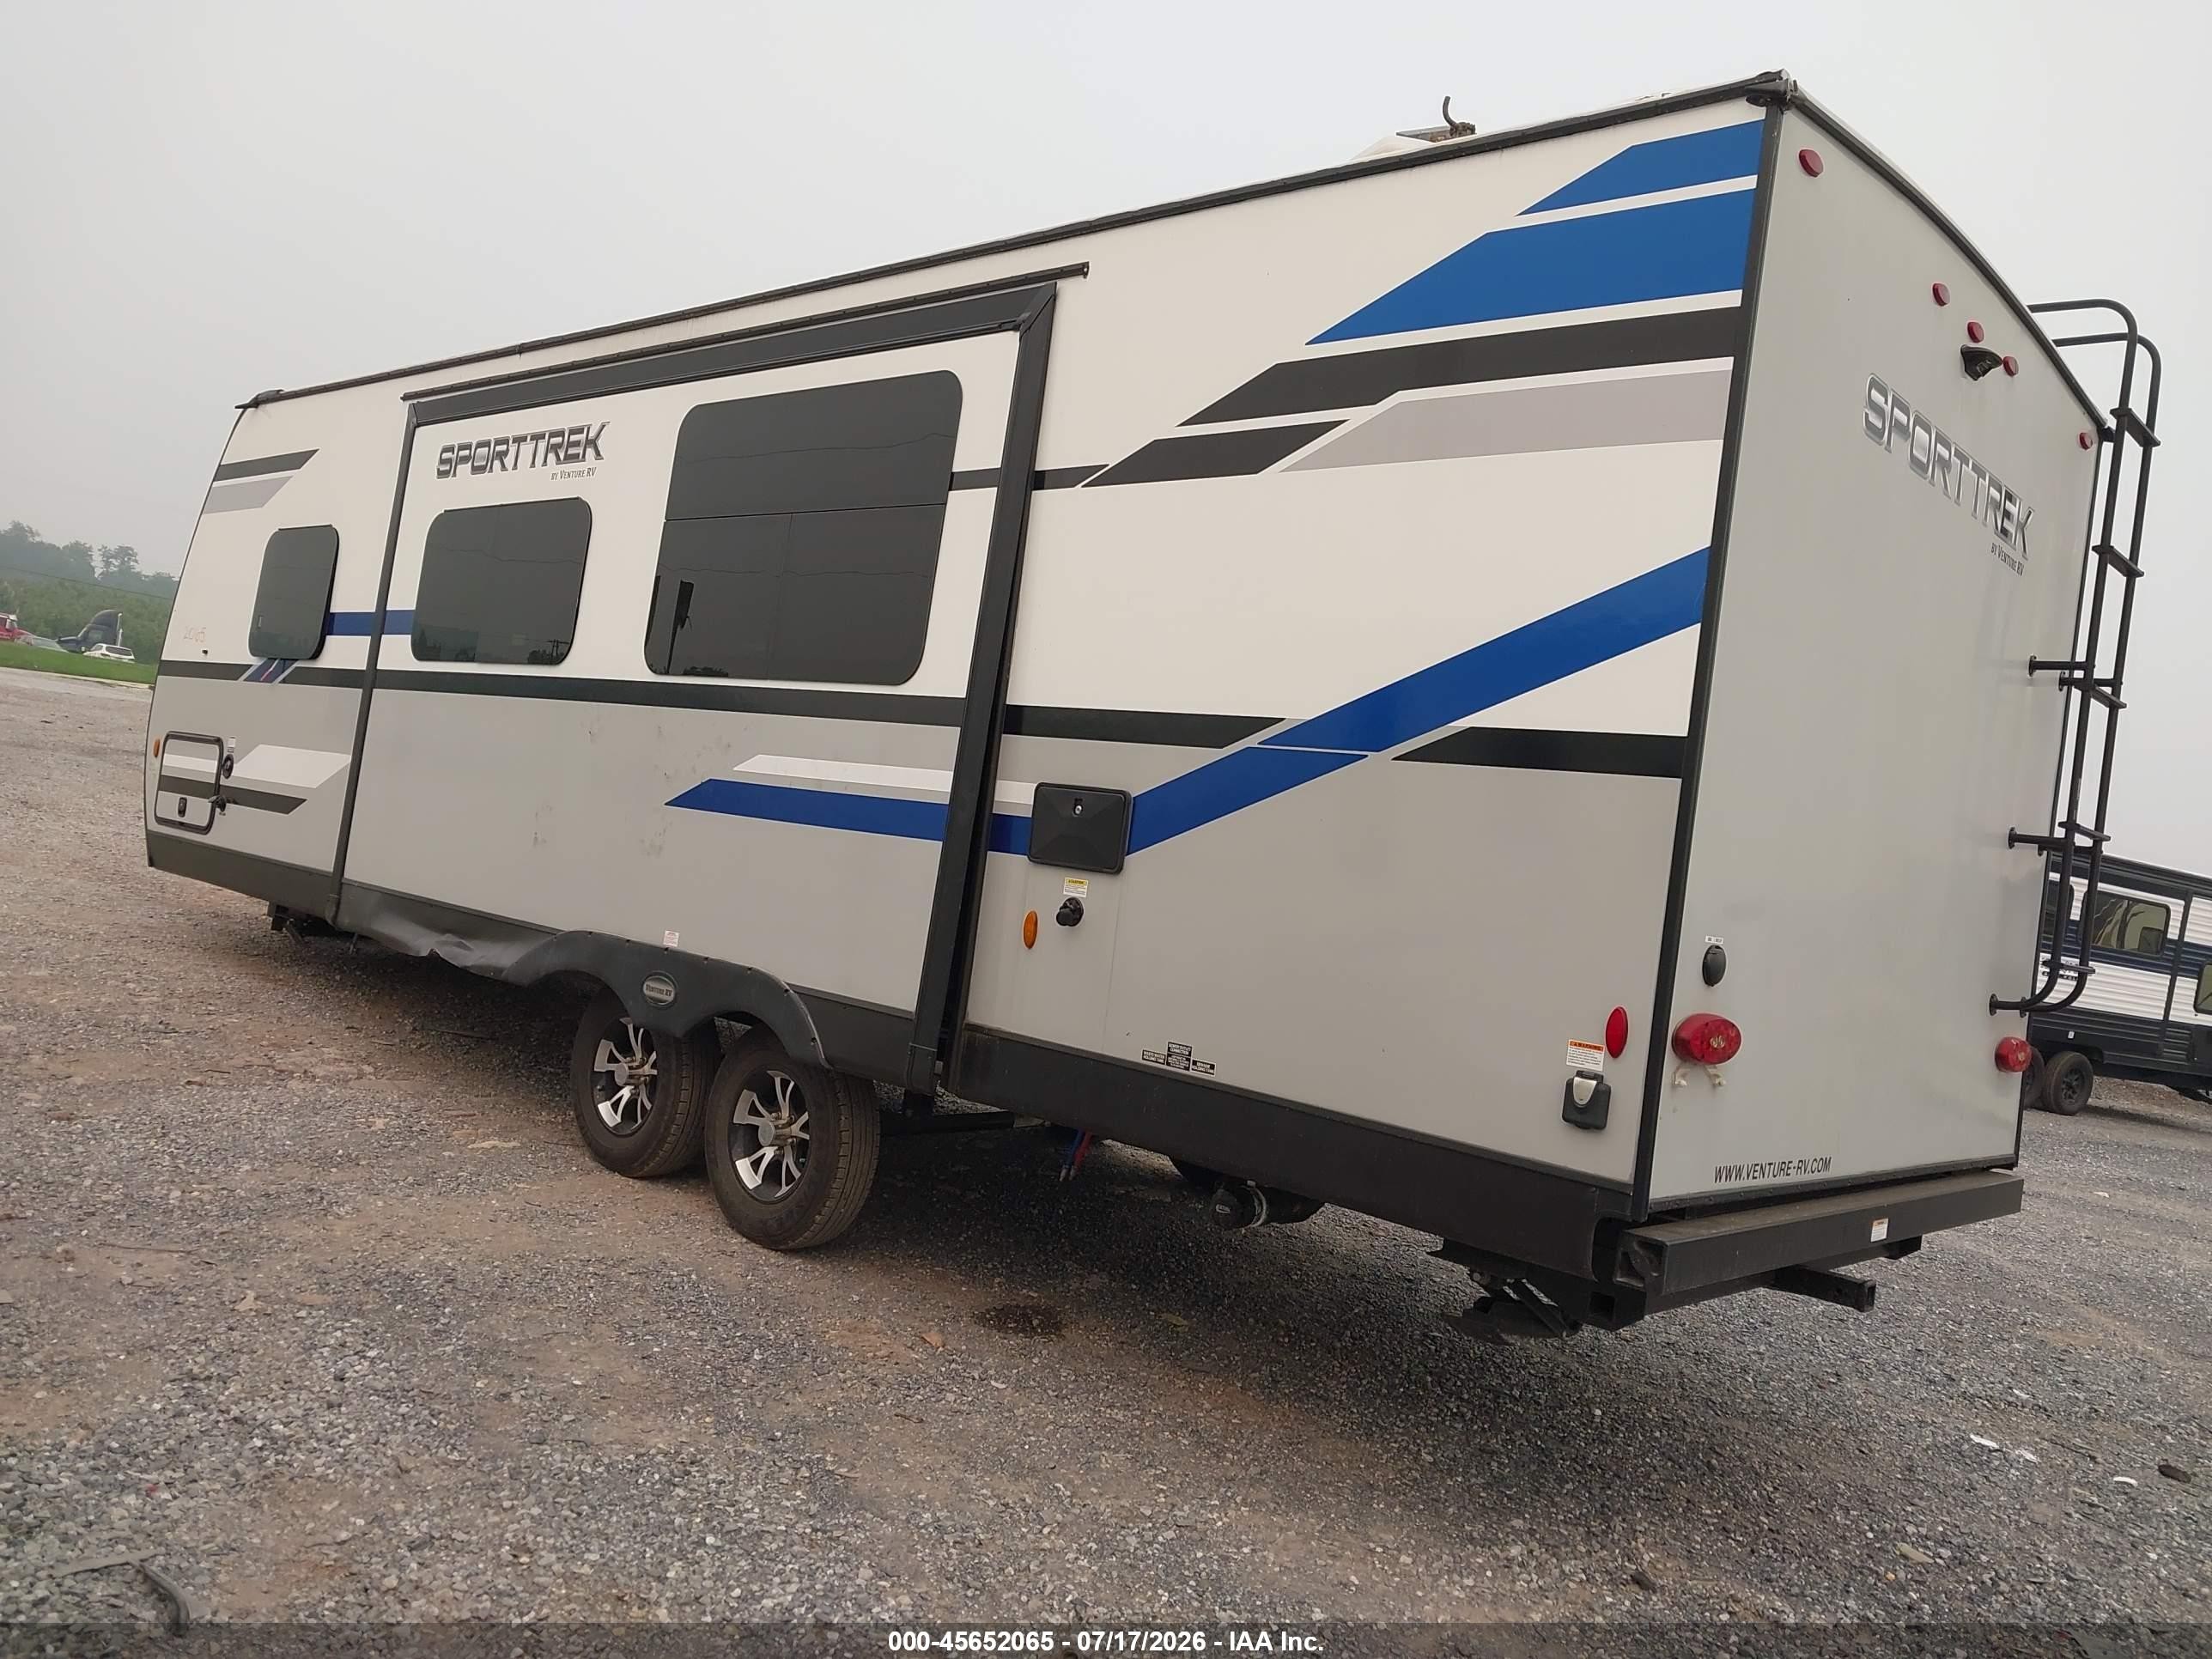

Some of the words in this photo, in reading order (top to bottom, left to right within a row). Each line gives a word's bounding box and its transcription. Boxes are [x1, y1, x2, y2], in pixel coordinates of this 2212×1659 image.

[436, 421, 611, 479] SPORTTREK
[586, 466, 597, 477] RV
[1863, 373, 2034, 560] SPORTTREK
[665, 988, 672, 997] RV
[1714, 1156, 1832, 1183] WWW.VENTURE-RV.COM
